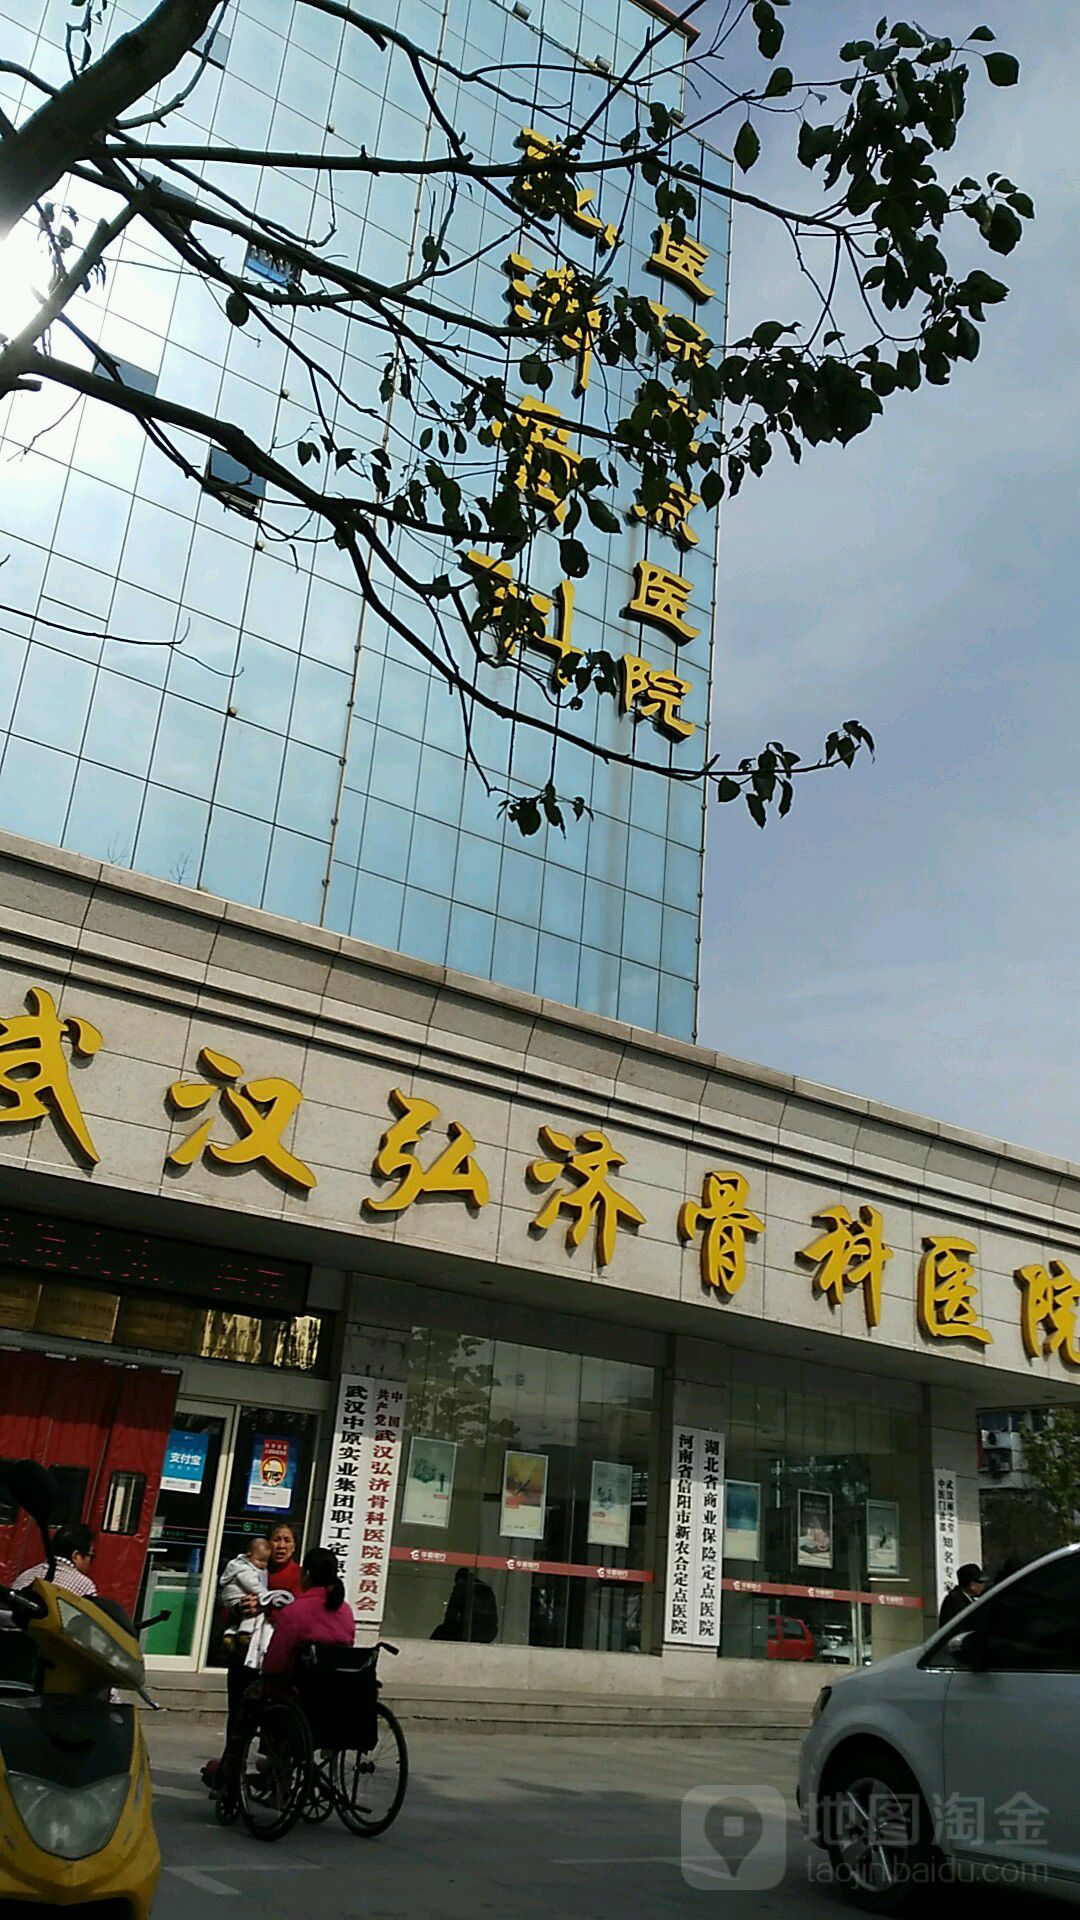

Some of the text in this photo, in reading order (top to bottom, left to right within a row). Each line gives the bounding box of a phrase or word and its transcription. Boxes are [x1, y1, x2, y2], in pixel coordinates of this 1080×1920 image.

[621, 221, 717, 741] 医保点医院
[0, 987, 1080, 1365] 武汉弘济骨科医院
[169, 1451, 202, 1466] 支付宝
[326, 1384, 369, 1579] 武汉中原实业集团职工定
[355, 1428, 397, 1613] 武汉弘济骨科医院委员会
[670, 1433, 694, 1636] 河南省信阳市新农合定点医院
[698, 1438, 720, 1637] 湖北省商业保险定点医院
